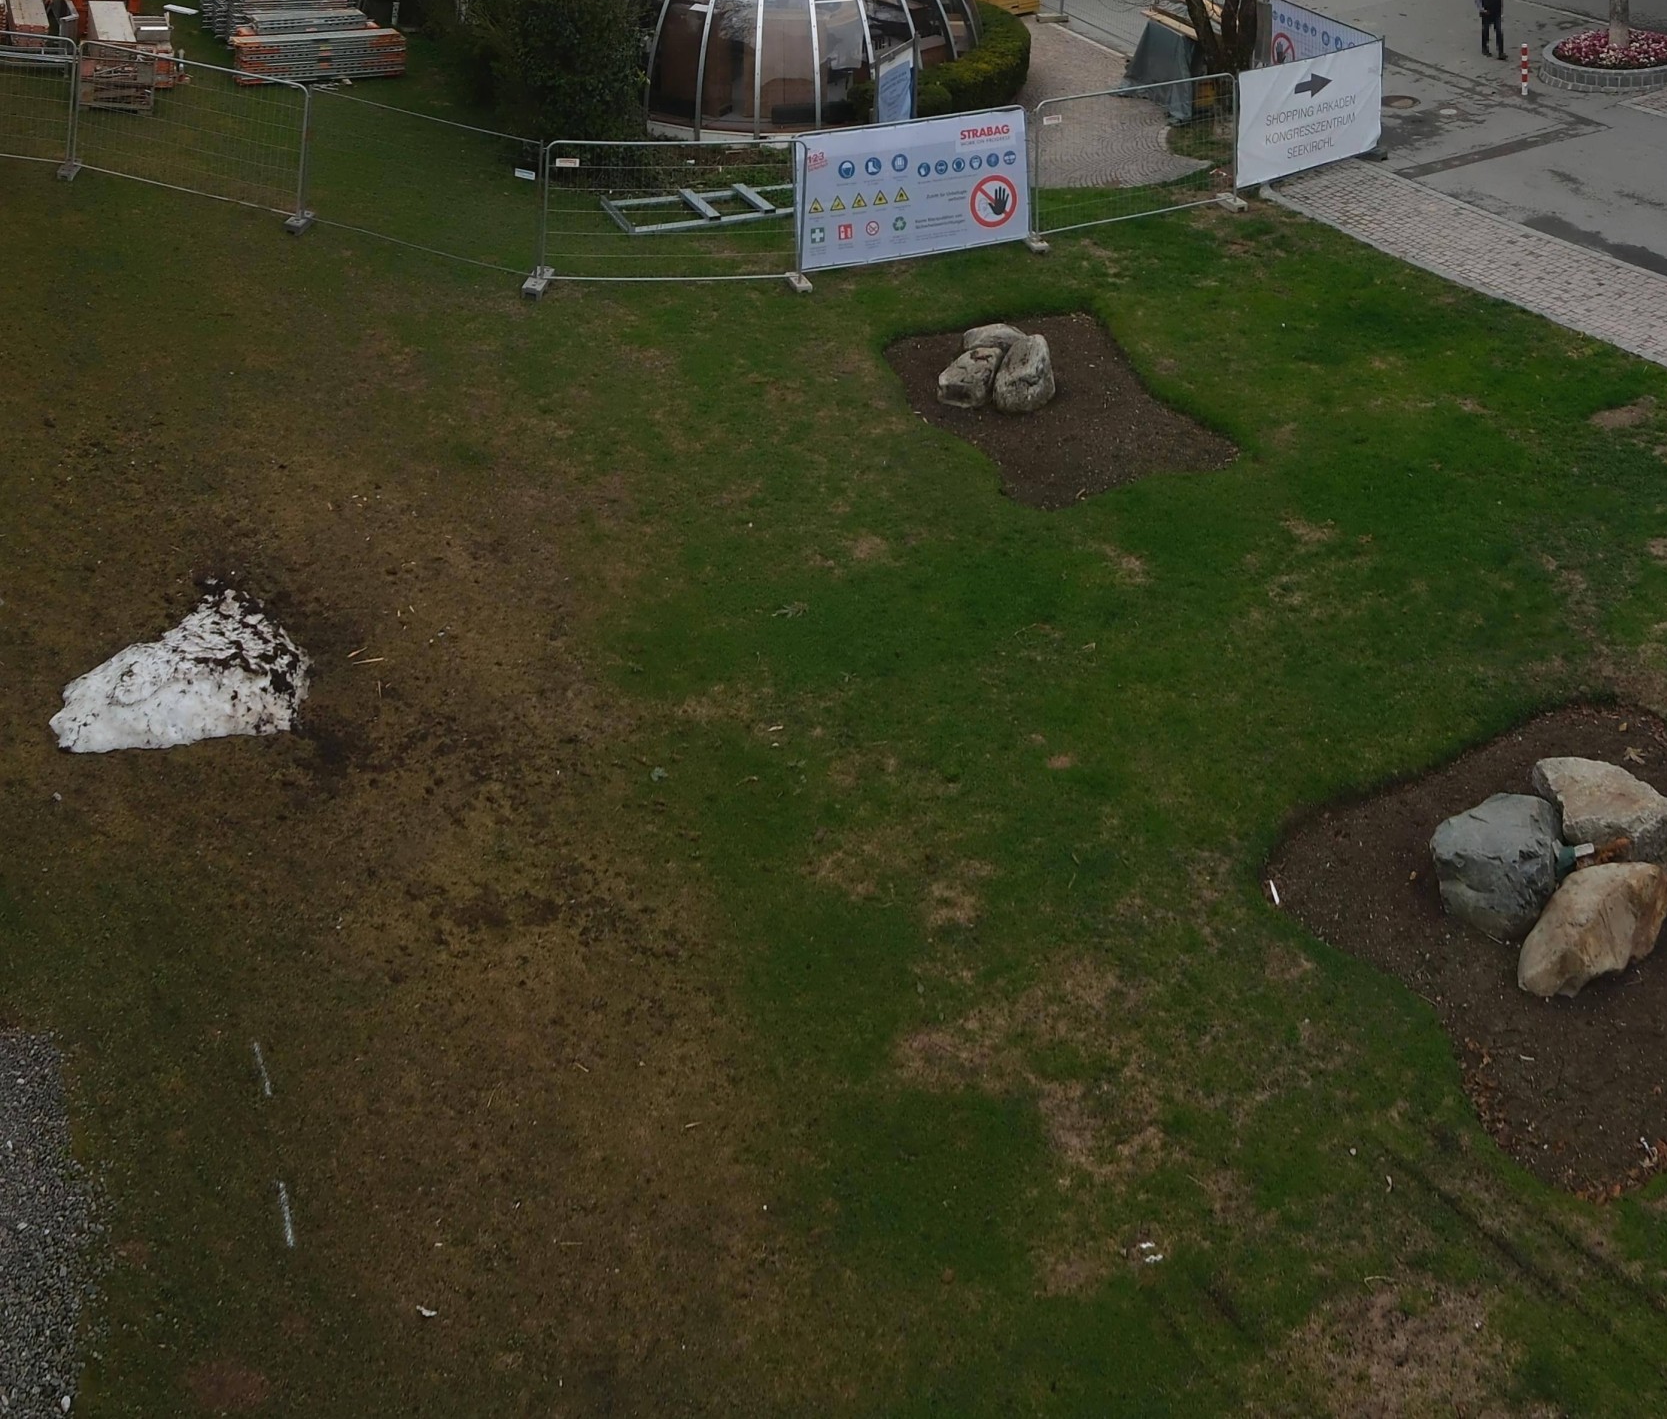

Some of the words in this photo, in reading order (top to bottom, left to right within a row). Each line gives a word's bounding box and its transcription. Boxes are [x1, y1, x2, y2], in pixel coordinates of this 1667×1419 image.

[1265, 106, 1314, 127] SHOPPING
[1316, 95, 1356, 115] ARKADEN
[960, 124, 1010, 140] STRABAG
[1265, 112, 1356, 145] KONGRESSZENTRUM
[1287, 137, 1335, 159] SEEKIRCHL
